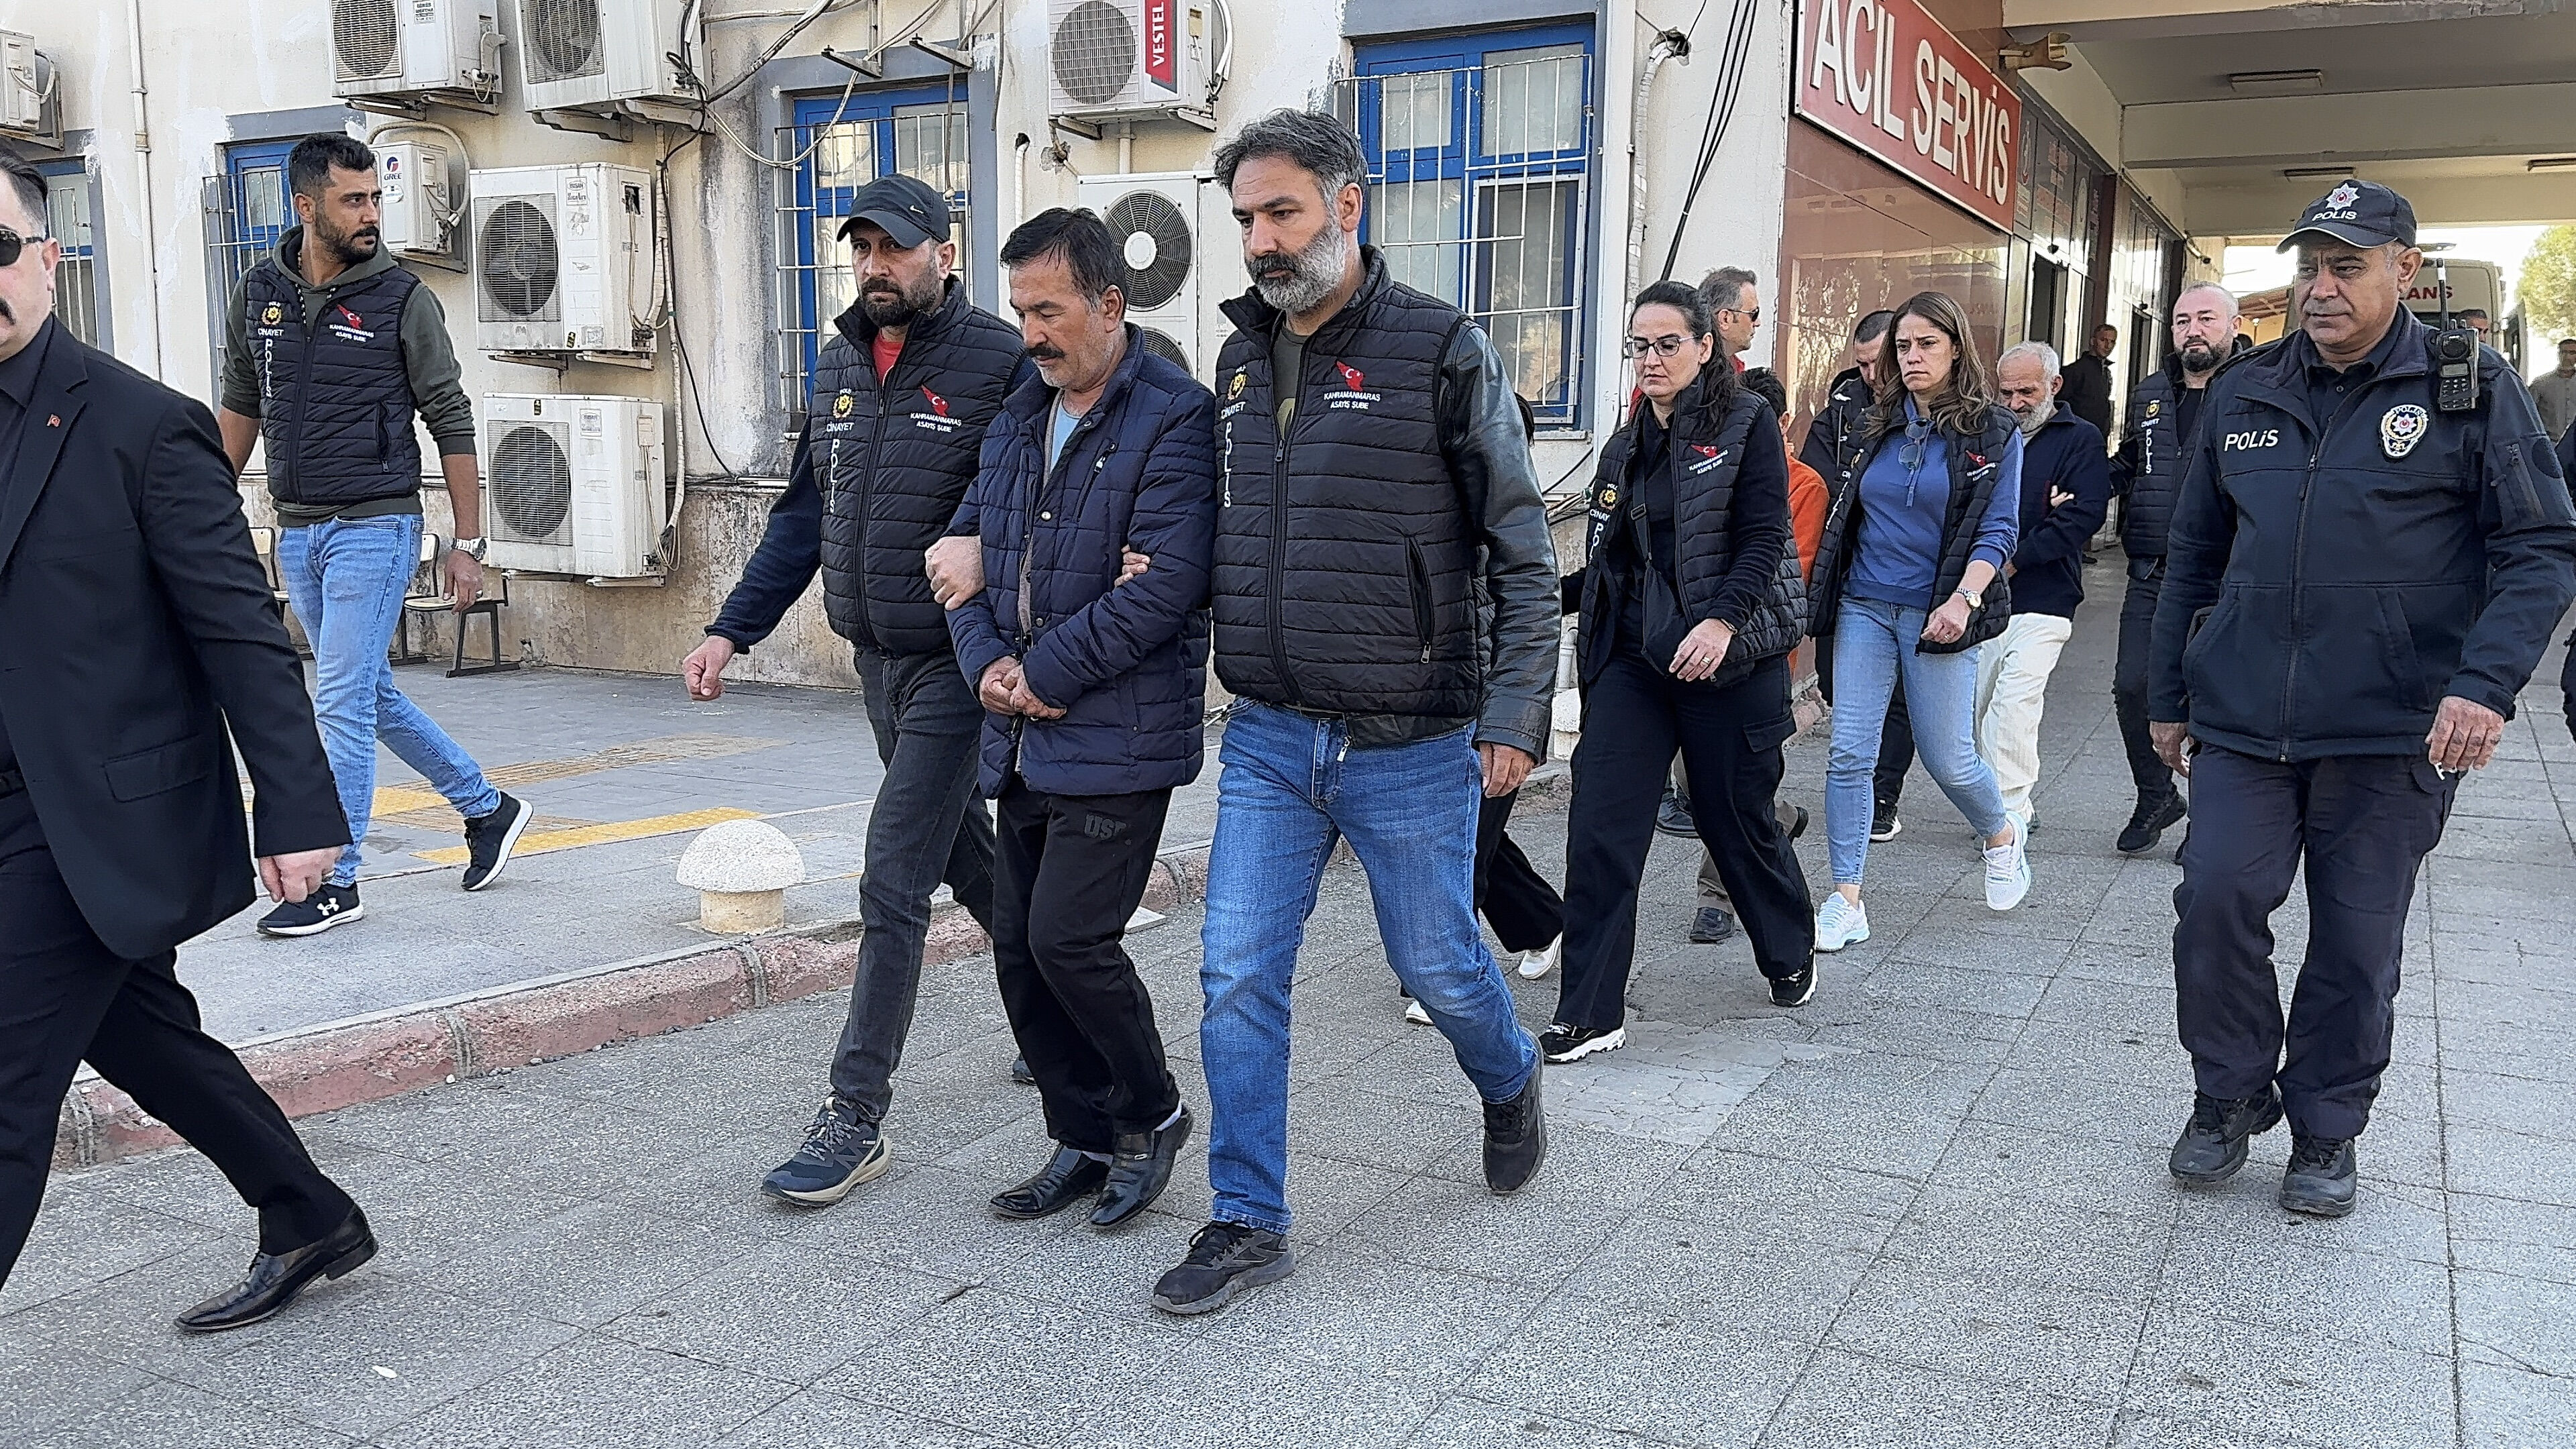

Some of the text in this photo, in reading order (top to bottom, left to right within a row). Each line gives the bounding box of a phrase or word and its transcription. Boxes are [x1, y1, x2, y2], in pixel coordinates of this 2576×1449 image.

[1152, 1, 1165, 67] VESTEL
[1913, 39, 2010, 205] SERVİS
[384, 172, 402, 180] GREE
[2224, 429, 2279, 451] POLİS
